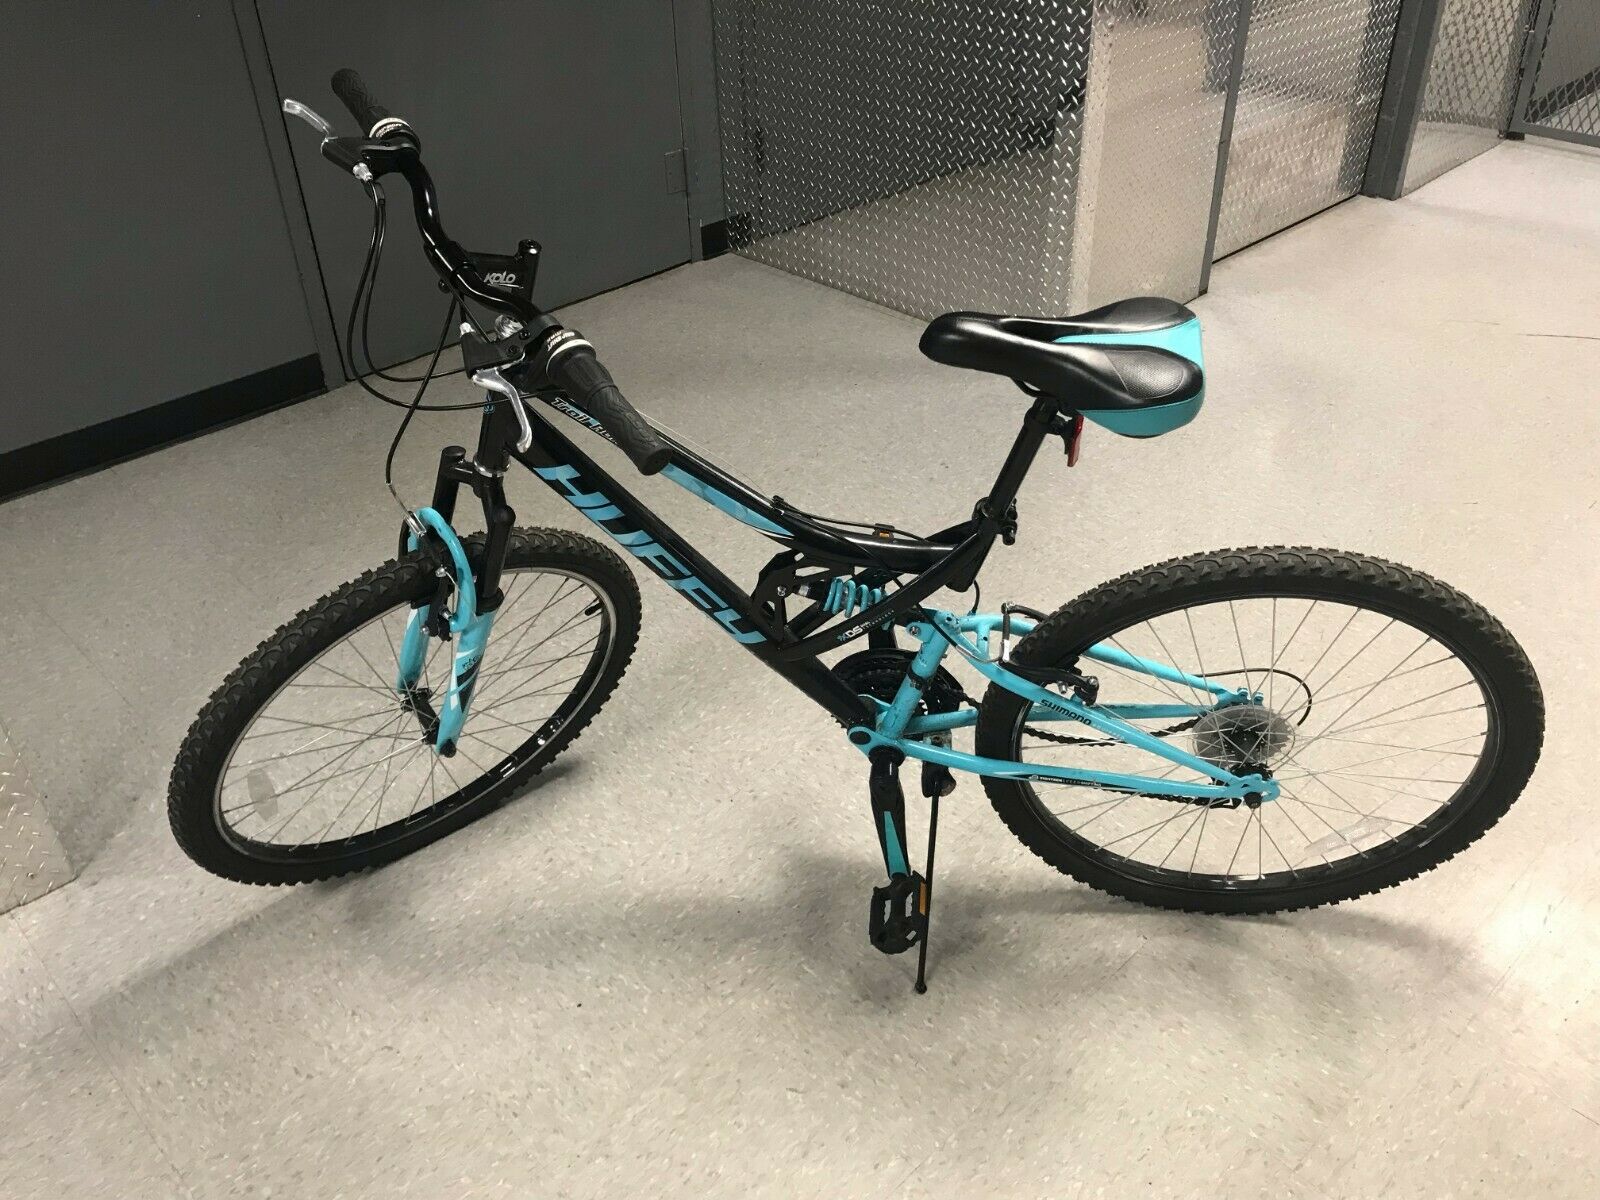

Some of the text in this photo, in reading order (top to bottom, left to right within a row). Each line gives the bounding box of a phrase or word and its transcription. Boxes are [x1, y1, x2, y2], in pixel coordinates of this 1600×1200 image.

[551, 396, 593, 424] Trail
[533, 464, 767, 644] HUFFY
[1041, 699, 1092, 726] SHIMANO
